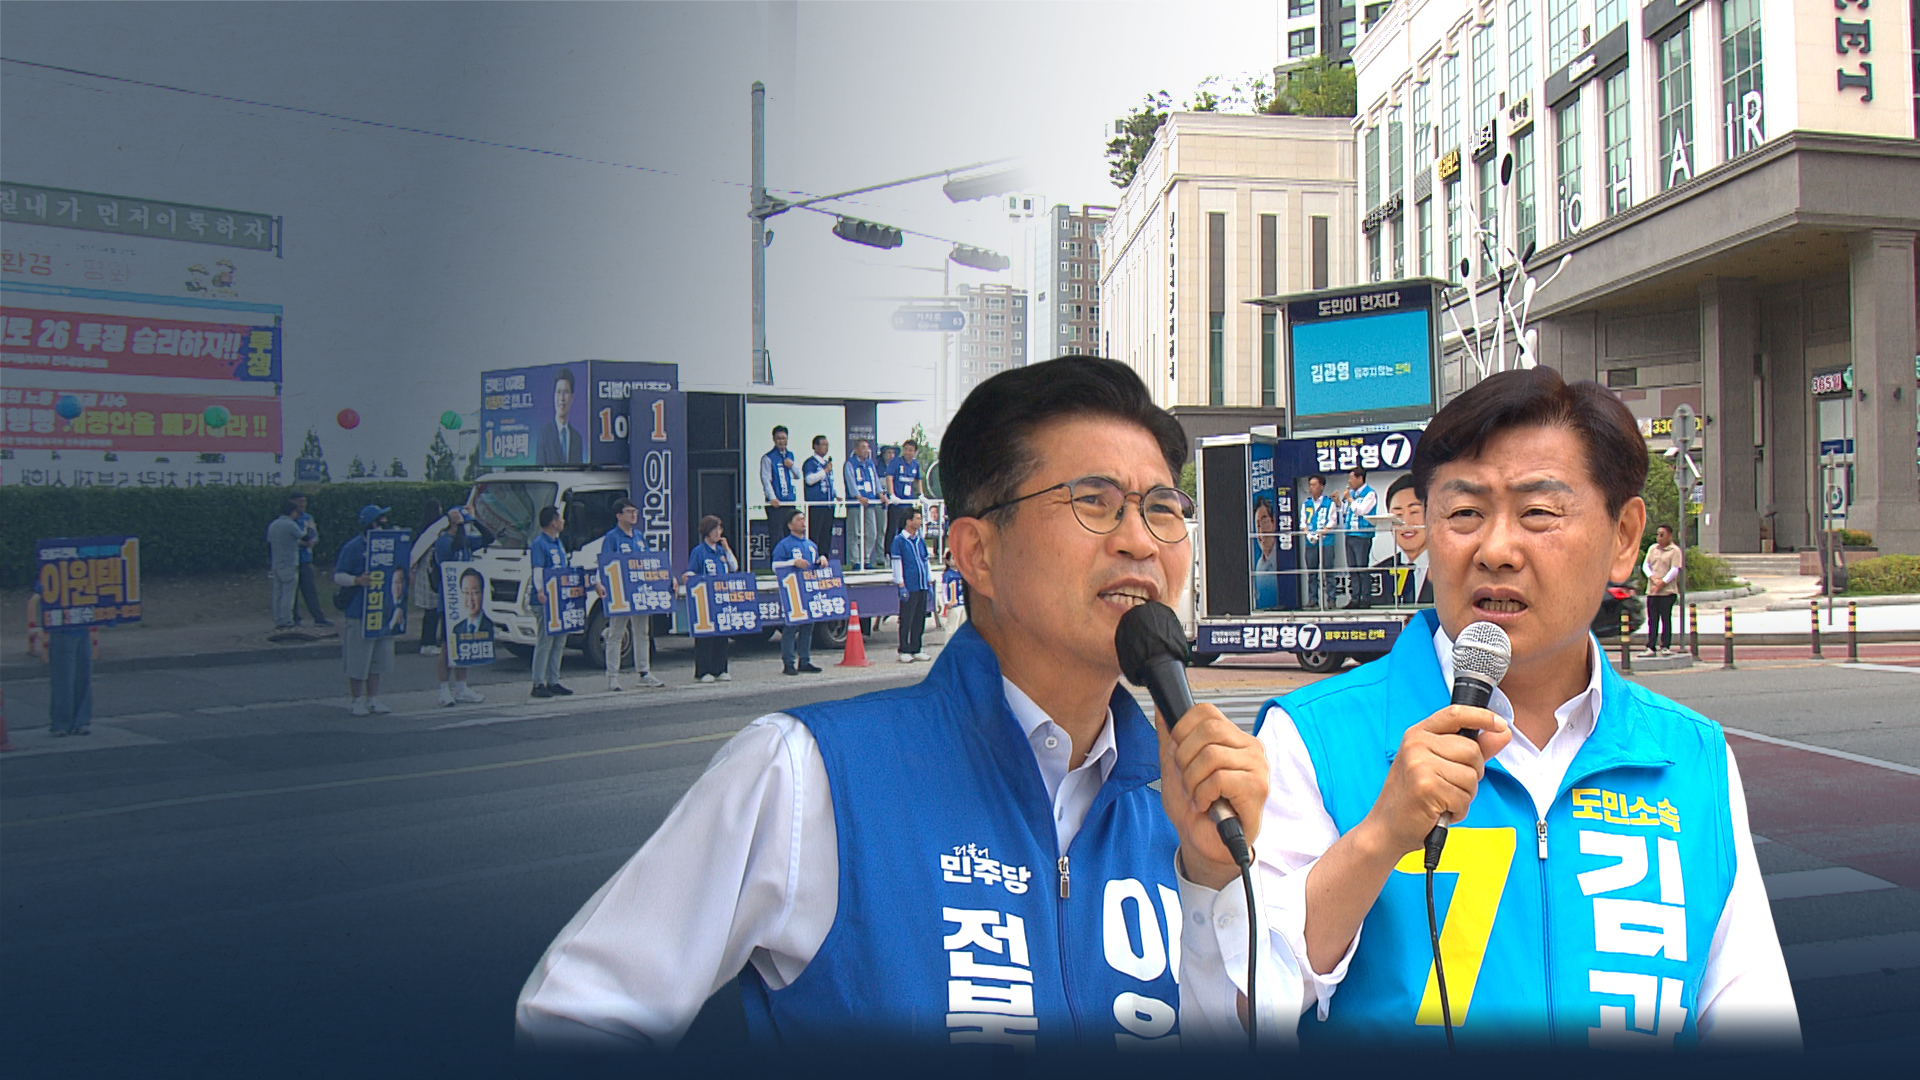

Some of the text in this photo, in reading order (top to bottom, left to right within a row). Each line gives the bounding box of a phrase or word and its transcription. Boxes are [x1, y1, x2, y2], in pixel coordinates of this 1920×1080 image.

[1835, 0, 1872, 101] ET
[1318, 291, 1401, 317] 도민이 먼저다
[37, 319, 71, 349] 26
[76, 322, 128, 352] 투쟁
[132, 326, 241, 360] 승리하자!!
[248, 331, 273, 377] 투쟁
[1311, 361, 1350, 384] 김관영
[0, 407, 55, 433] 행령
[599, 407, 615, 442] 1
[651, 399, 668, 442] 1
[1316, 437, 1406, 472] 김관영 7
[40, 538, 140, 607] 이원택 1
[603, 559, 631, 614] 1
[367, 571, 385, 631] 유희태
[546, 576, 562, 632] 1
[632, 591, 672, 611] 민주당
[691, 581, 715, 634] 1
[782, 572, 809, 623] 1
[808, 597, 845, 618] 민주당
[717, 611, 756, 632] 민주당
[1243, 626, 1297, 649] 김관영
[459, 641, 494, 661] 유희태
[1571, 788, 1681, 833] 도민소속
[952, 842, 989, 859] 더불어
[940, 853, 1031, 894] 민주당
[1393, 827, 1517, 1027] 7
[942, 906, 1039, 1050] 전북
